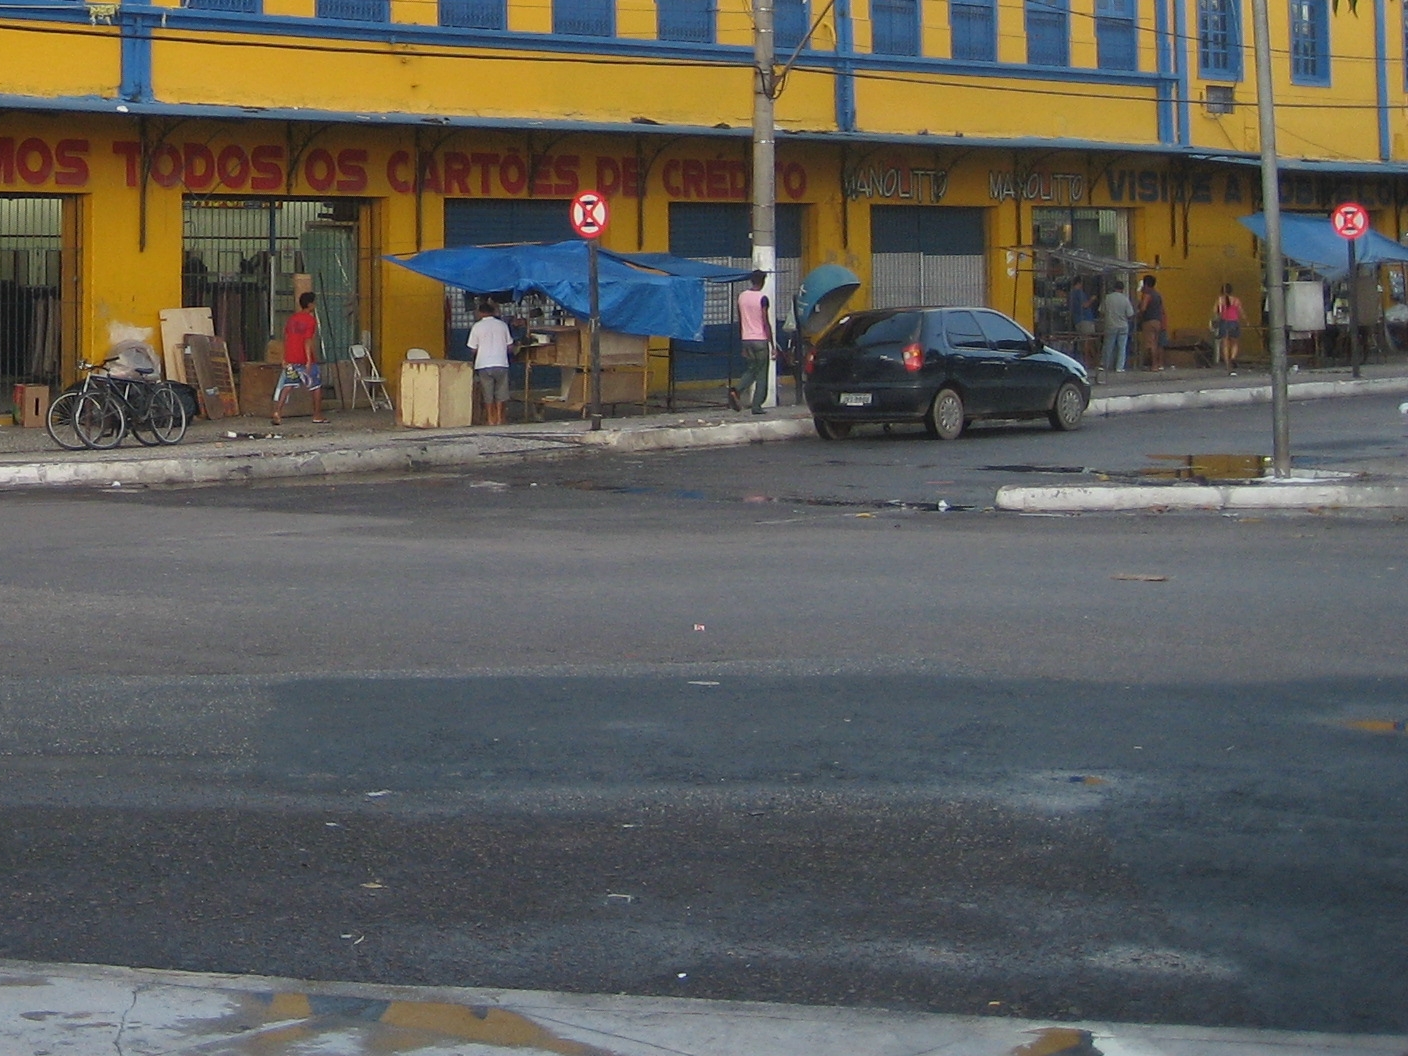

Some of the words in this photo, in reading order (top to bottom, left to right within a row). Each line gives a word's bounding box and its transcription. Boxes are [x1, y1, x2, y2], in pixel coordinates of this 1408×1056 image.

[112, 140, 284, 191] TODOS
[305, 147, 369, 192] OS
[386, 147, 581, 195] CARTÕES
[595, 155, 647, 198] DE
